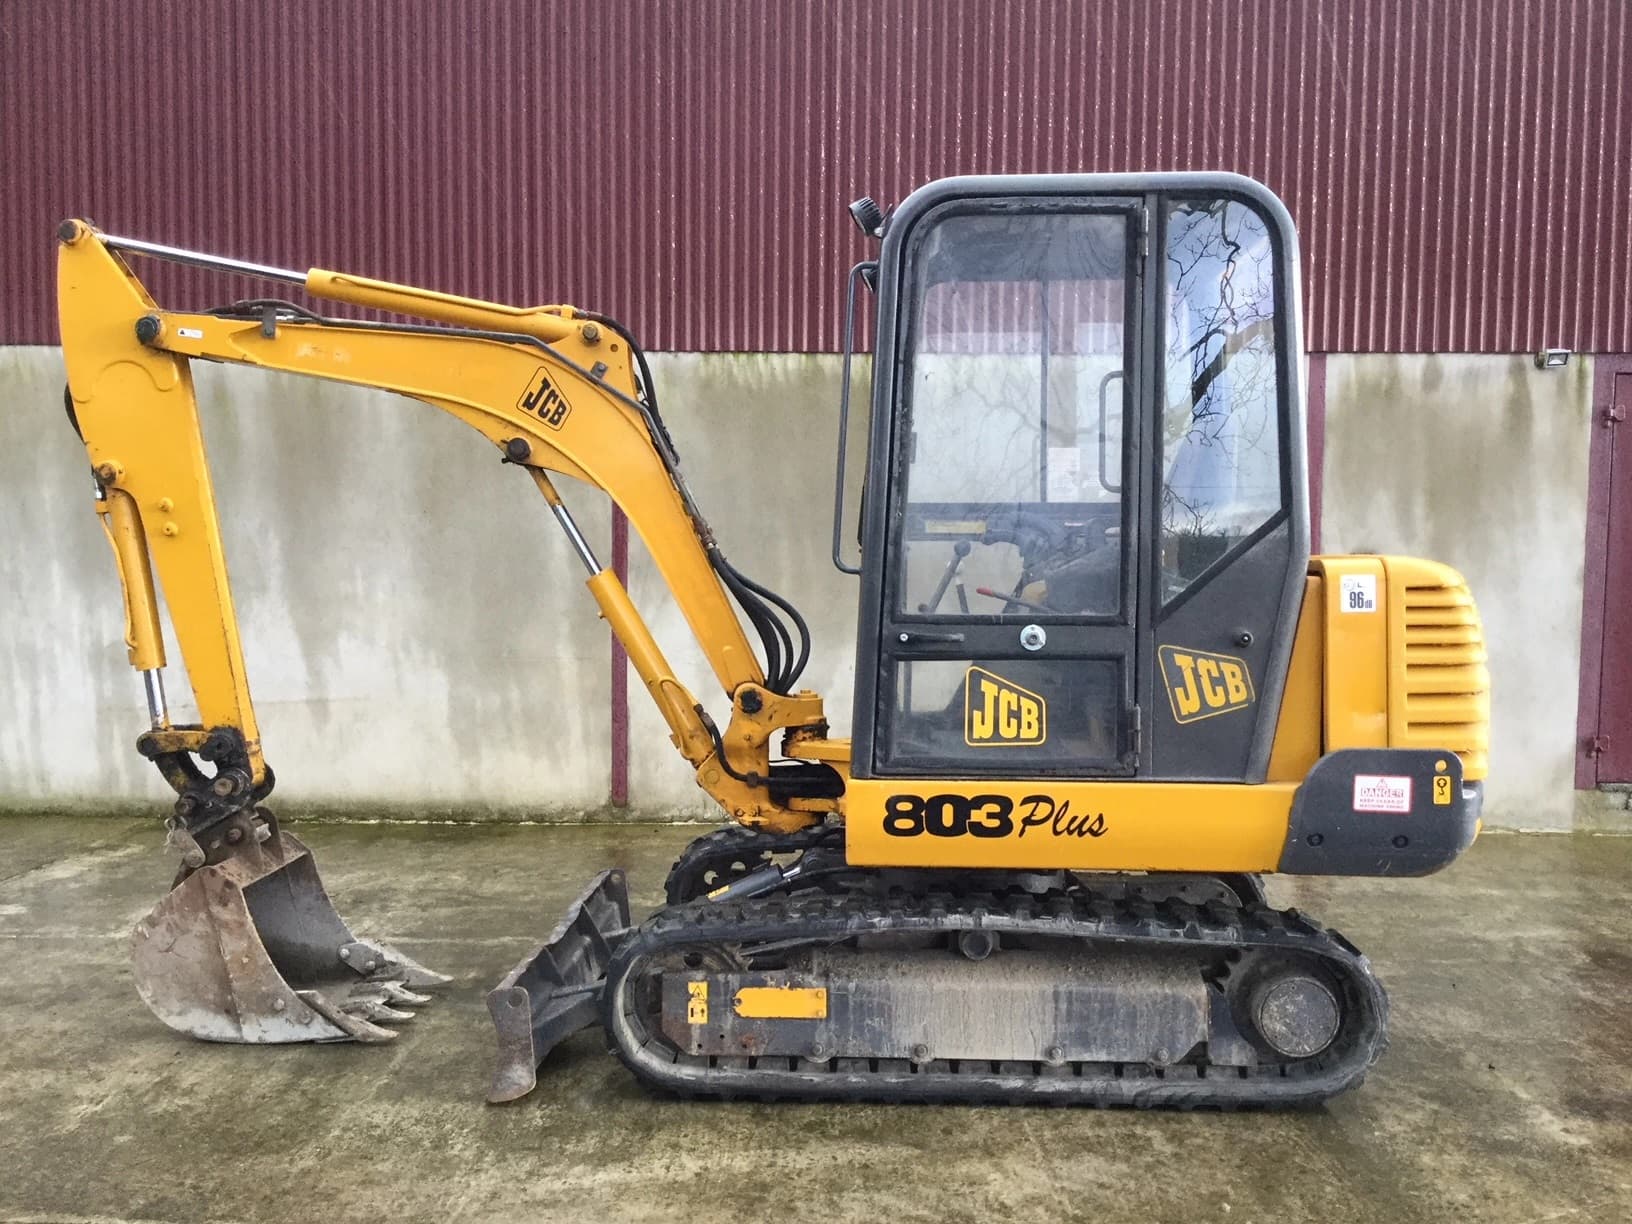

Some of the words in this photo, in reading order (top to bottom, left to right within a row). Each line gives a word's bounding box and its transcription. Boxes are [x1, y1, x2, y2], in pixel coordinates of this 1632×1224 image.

[522, 377, 567, 425] JCB
[972, 678, 1039, 739] JCB
[1173, 653, 1248, 716] JCB
[883, 794, 1014, 838] 803
[1018, 794, 1109, 838] Plus
[1360, 787, 1404, 798] DANGER
